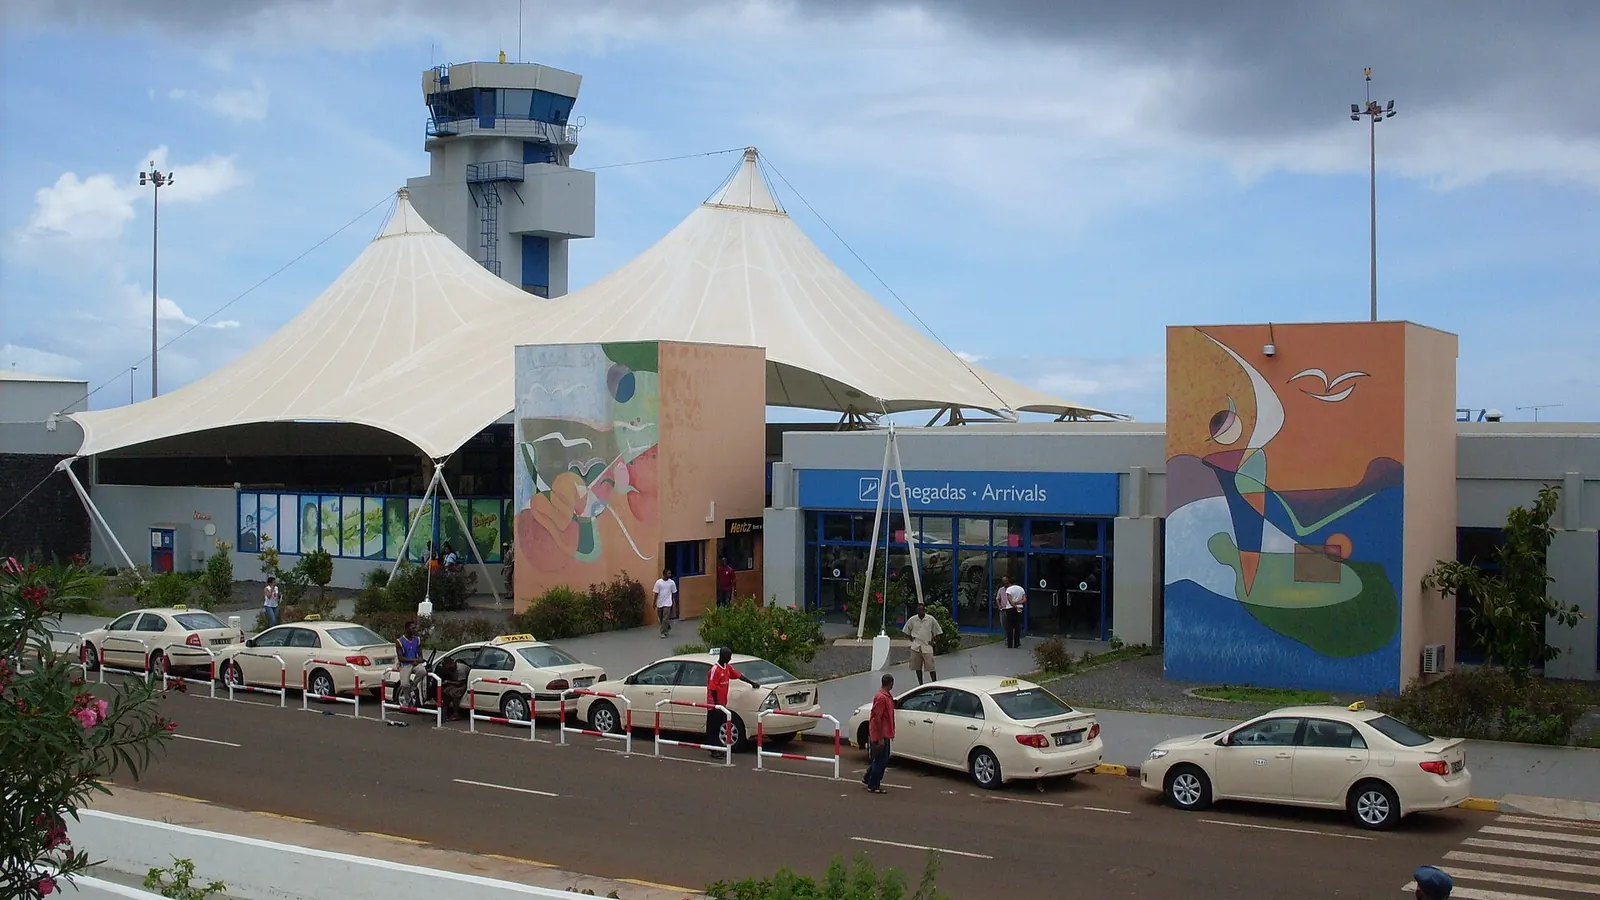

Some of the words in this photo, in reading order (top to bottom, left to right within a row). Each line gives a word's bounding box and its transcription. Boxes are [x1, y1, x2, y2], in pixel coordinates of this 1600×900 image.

[889, 482, 966, 504] Chegadas
[981, 483, 1046, 502] Arrivals
[730, 522, 752, 534] Hertz
